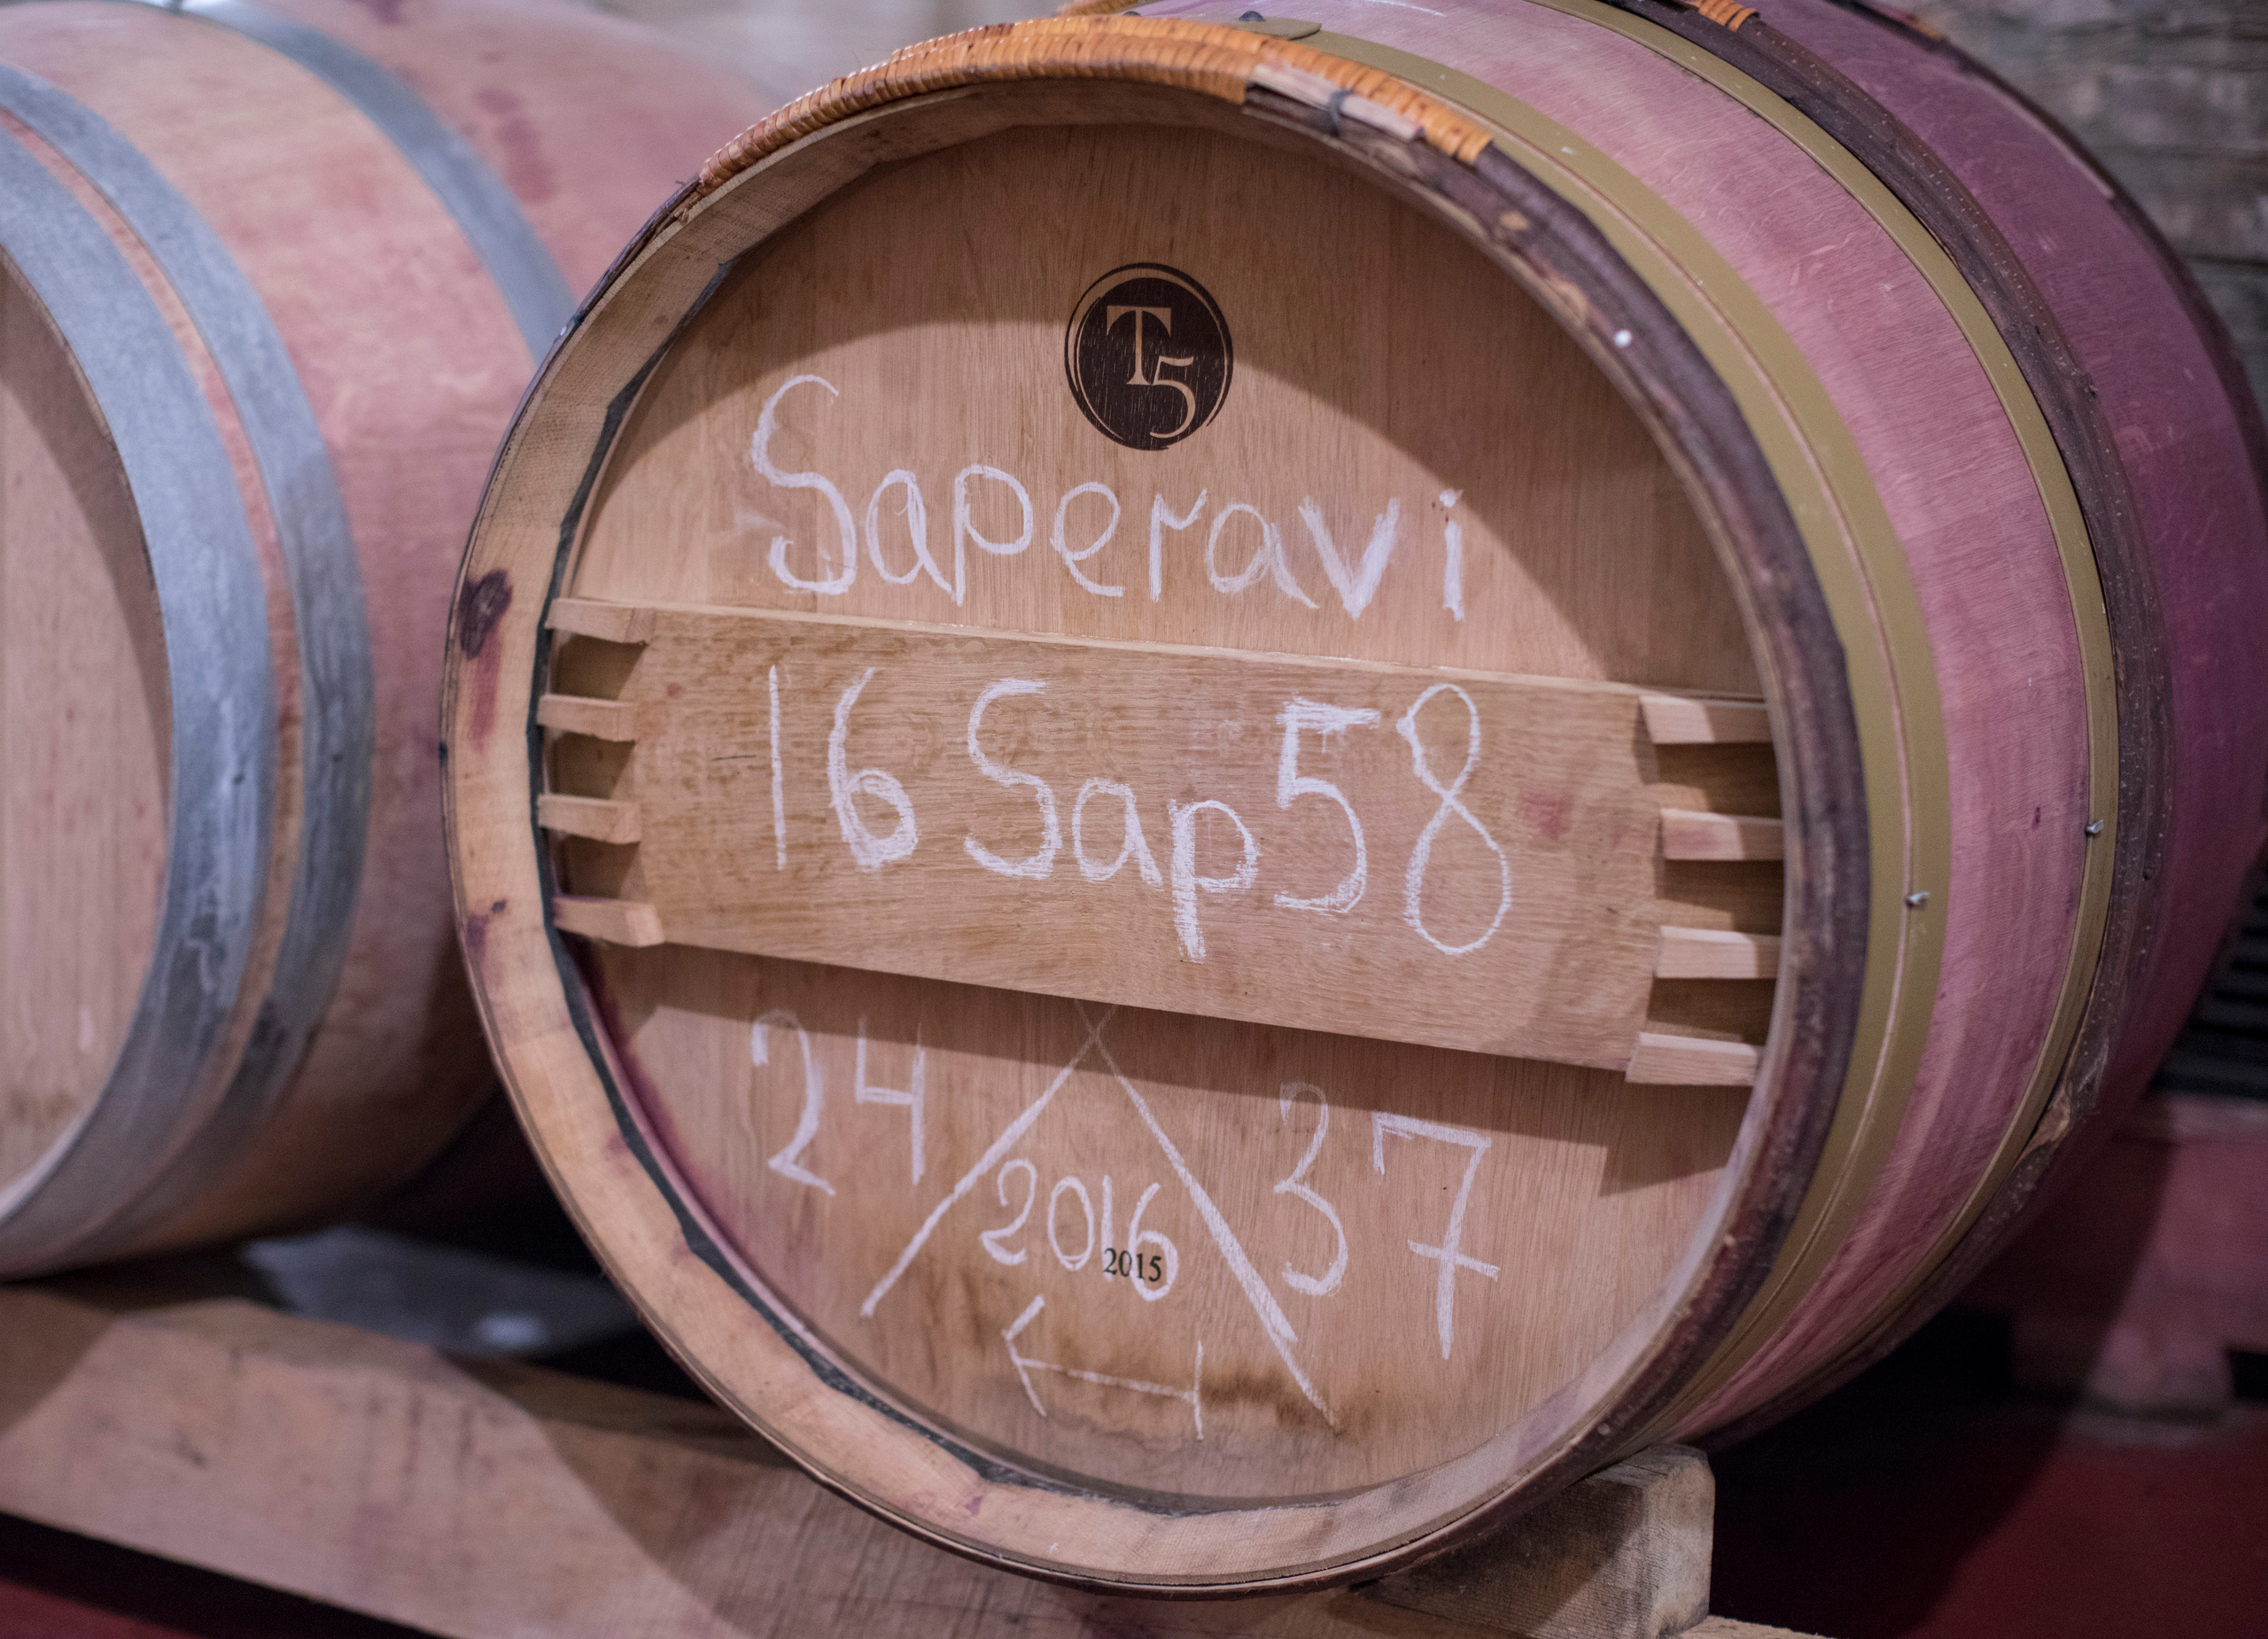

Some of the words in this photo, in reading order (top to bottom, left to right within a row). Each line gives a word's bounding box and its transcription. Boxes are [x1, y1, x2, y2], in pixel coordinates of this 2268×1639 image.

[751, 375, 1463, 621] Saperavi
[750, 1008, 926, 1197] 24
[979, 1157, 1179, 1301] 2016
[1104, 1247, 1162, 1282] 2015
[1273, 1081, 1500, 1360] 37
